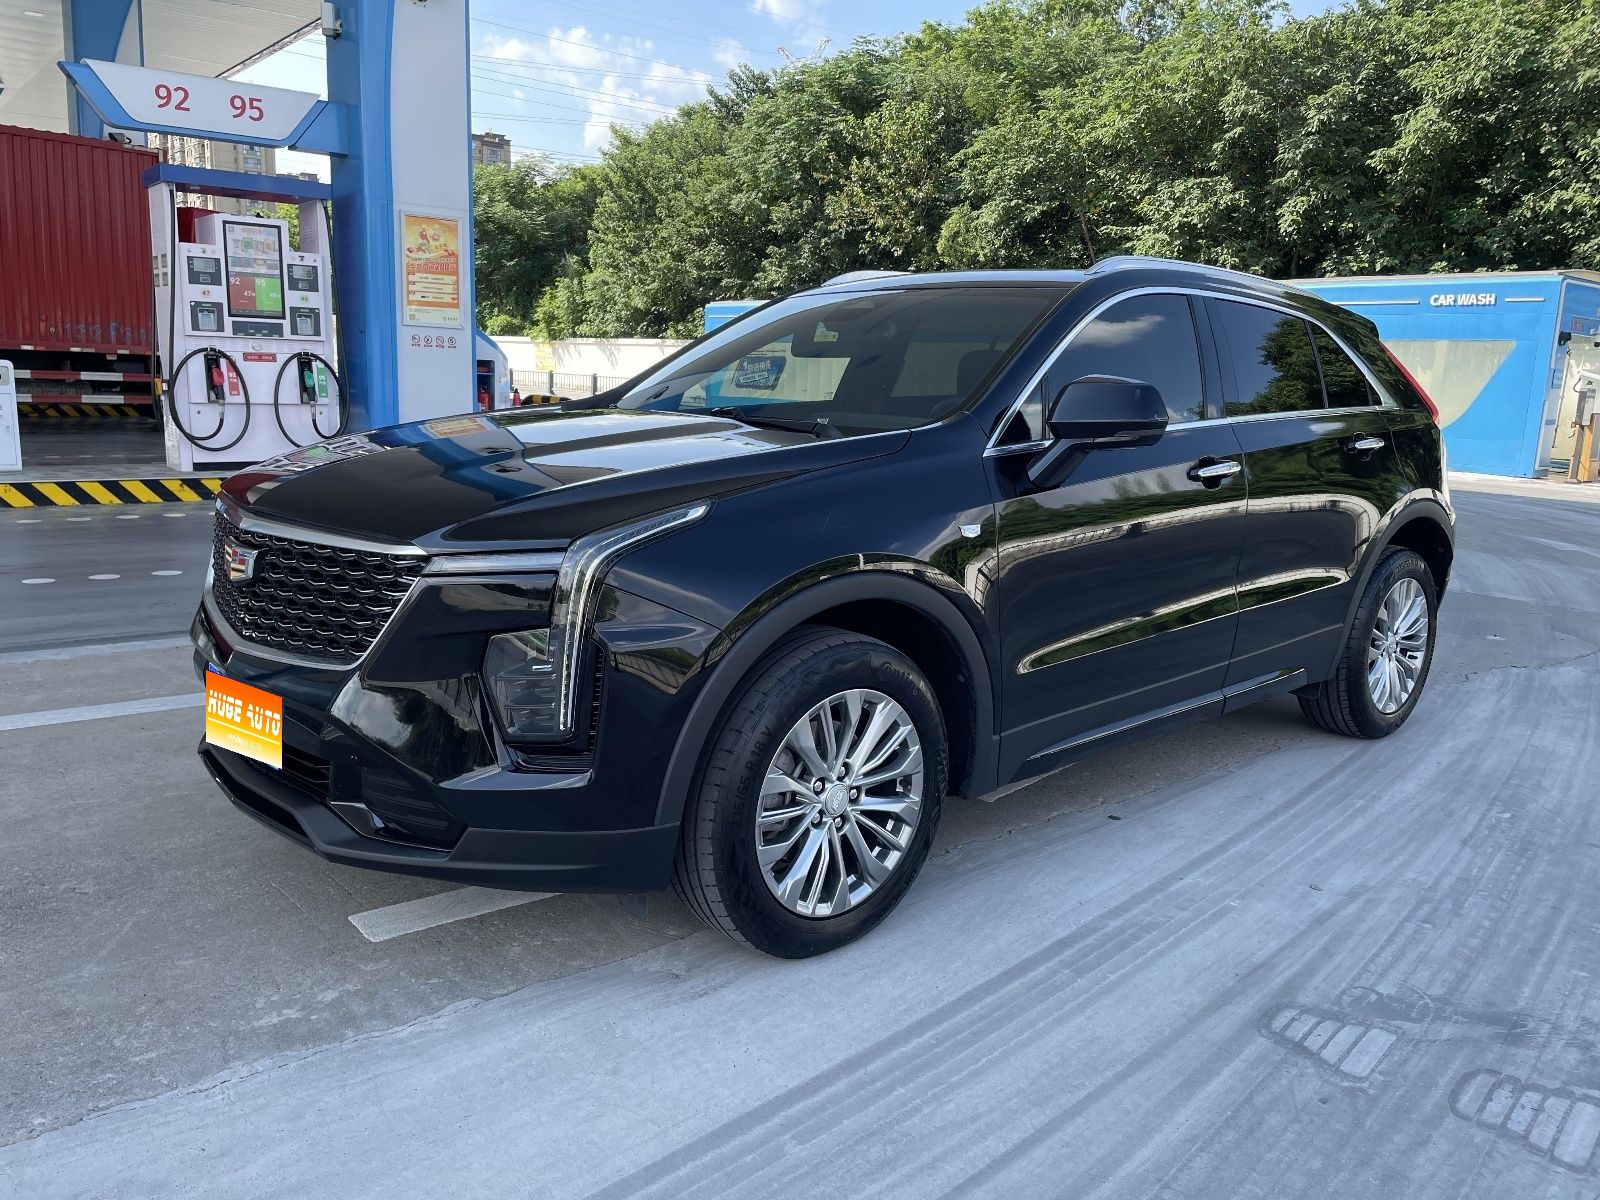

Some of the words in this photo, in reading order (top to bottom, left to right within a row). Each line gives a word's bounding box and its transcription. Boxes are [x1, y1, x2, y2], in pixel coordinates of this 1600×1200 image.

[154, 83, 190, 111] 92
[229, 95, 264, 121] 95
[230, 277, 240, 285] 92
[256, 279, 266, 287] 95
[1430, 294, 1456, 306] CAR
[1458, 293, 1496, 306] WASH
